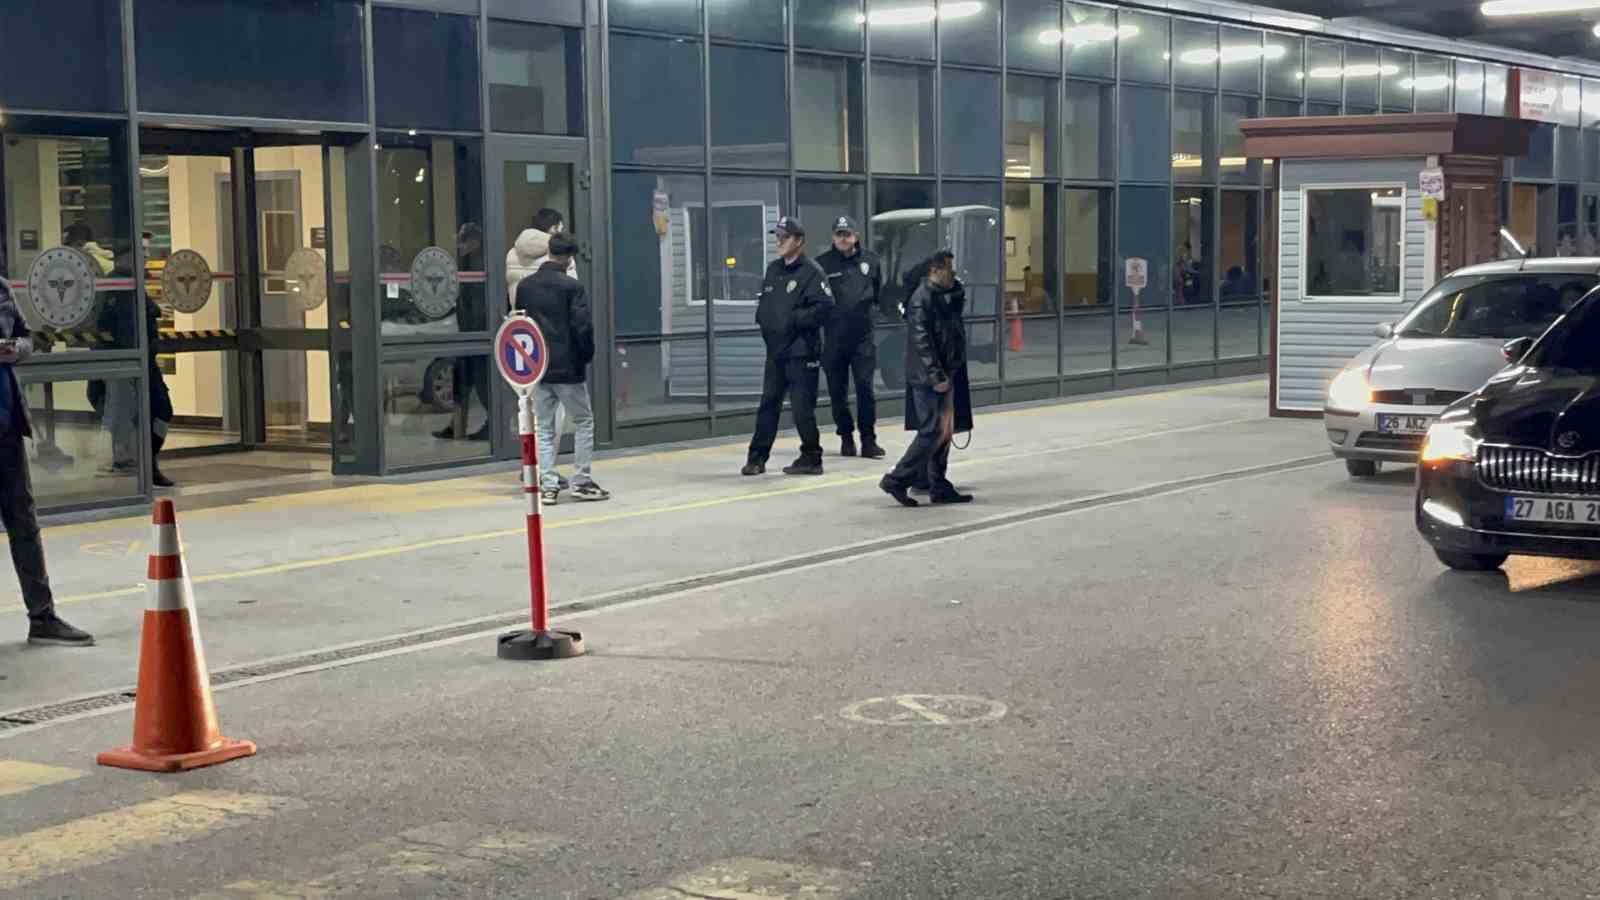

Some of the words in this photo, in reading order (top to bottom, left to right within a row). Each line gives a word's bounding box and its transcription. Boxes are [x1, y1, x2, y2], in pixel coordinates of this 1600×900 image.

[512, 333, 535, 372] P
[1384, 416, 1400, 429] 26
[1515, 499, 1535, 518] 27
[1544, 501, 1575, 521] AGA
[1586, 503, 1600, 522] 2
